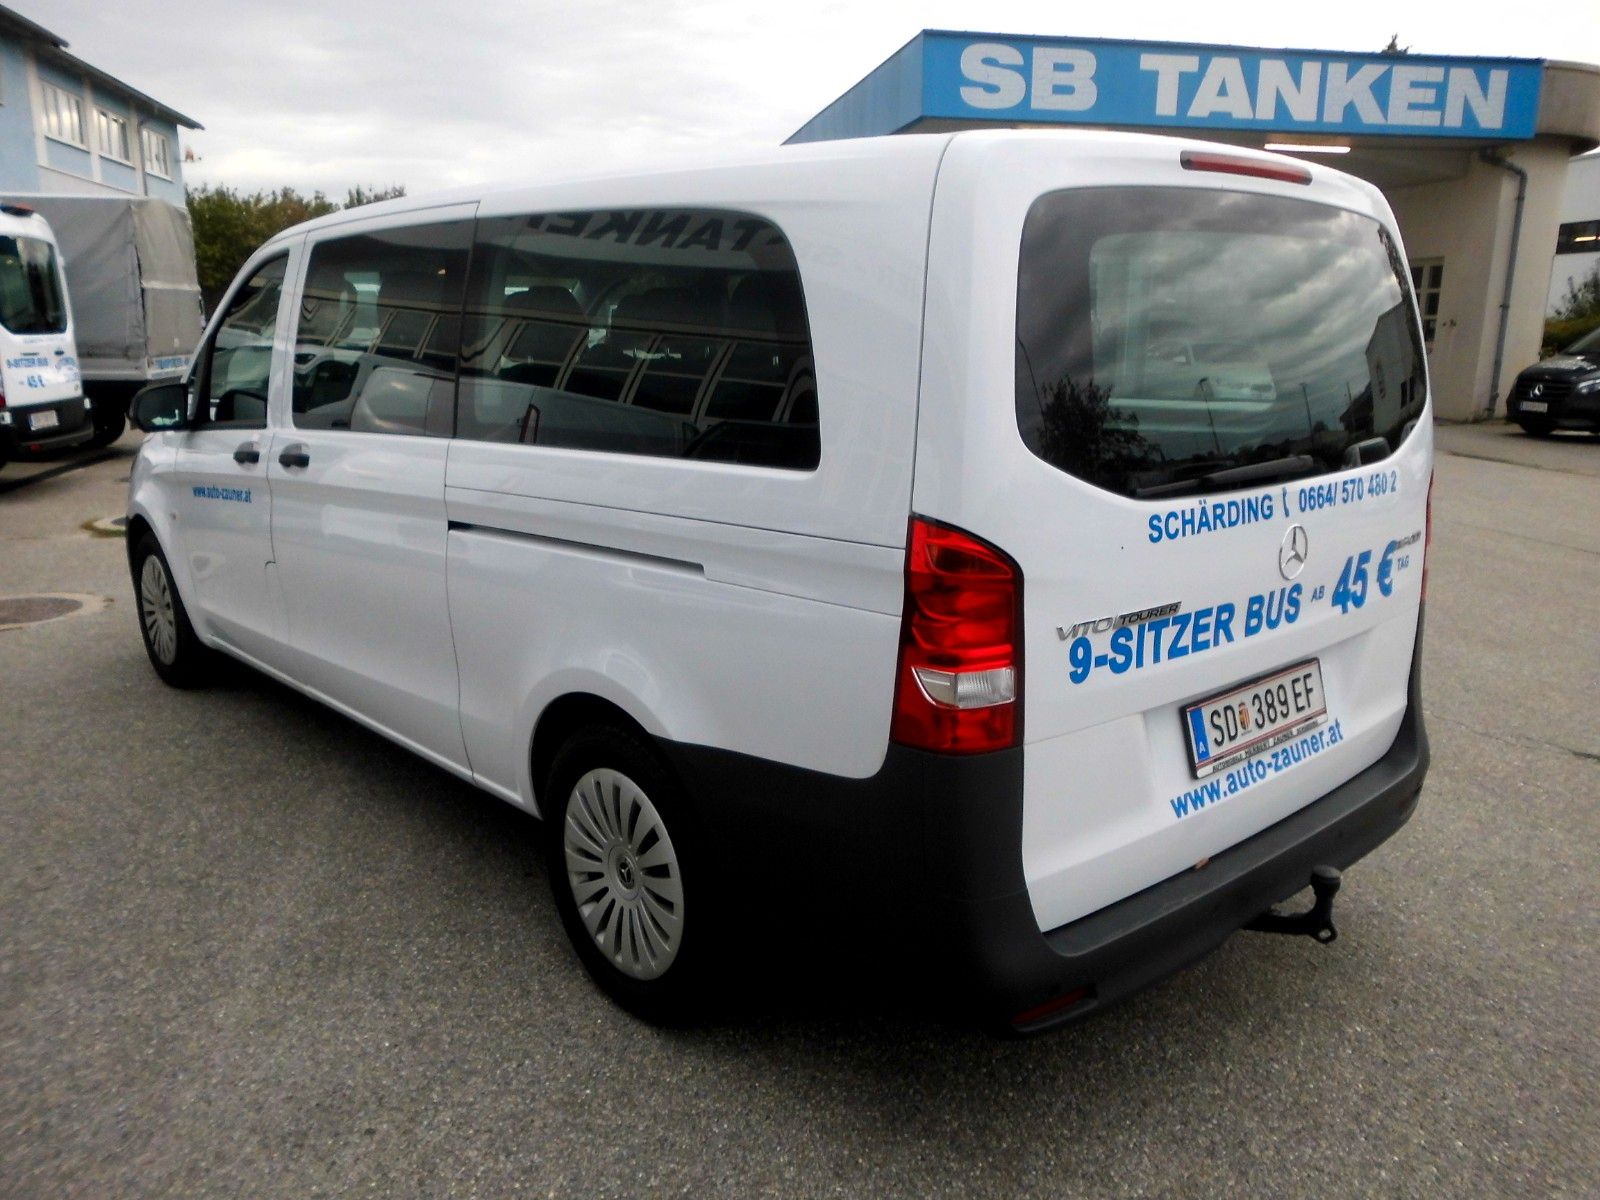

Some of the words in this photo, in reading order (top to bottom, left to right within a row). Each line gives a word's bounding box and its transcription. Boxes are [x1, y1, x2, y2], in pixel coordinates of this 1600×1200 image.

[959, 43, 1098, 110] SB
[1140, 53, 1508, 129] TANKEN
[1148, 494, 1274, 543] SCHÄRDING
[1299, 482, 1338, 512] 0664/
[1342, 477, 1365, 504] 570
[1368, 472, 1388, 497] 480
[1390, 470, 1397, 493] 2
[1056, 617, 1114, 642] VITO
[1119, 602, 1182, 627] TOURER
[1069, 602, 1236, 685] 9-SITZER
[1245, 583, 1304, 638] BUS
[1311, 585, 1325, 602] AB
[1331, 549, 1373, 614] 45
[1210, 704, 1239, 747] SD
[1170, 717, 1345, 818] www.auto-zauner.at
